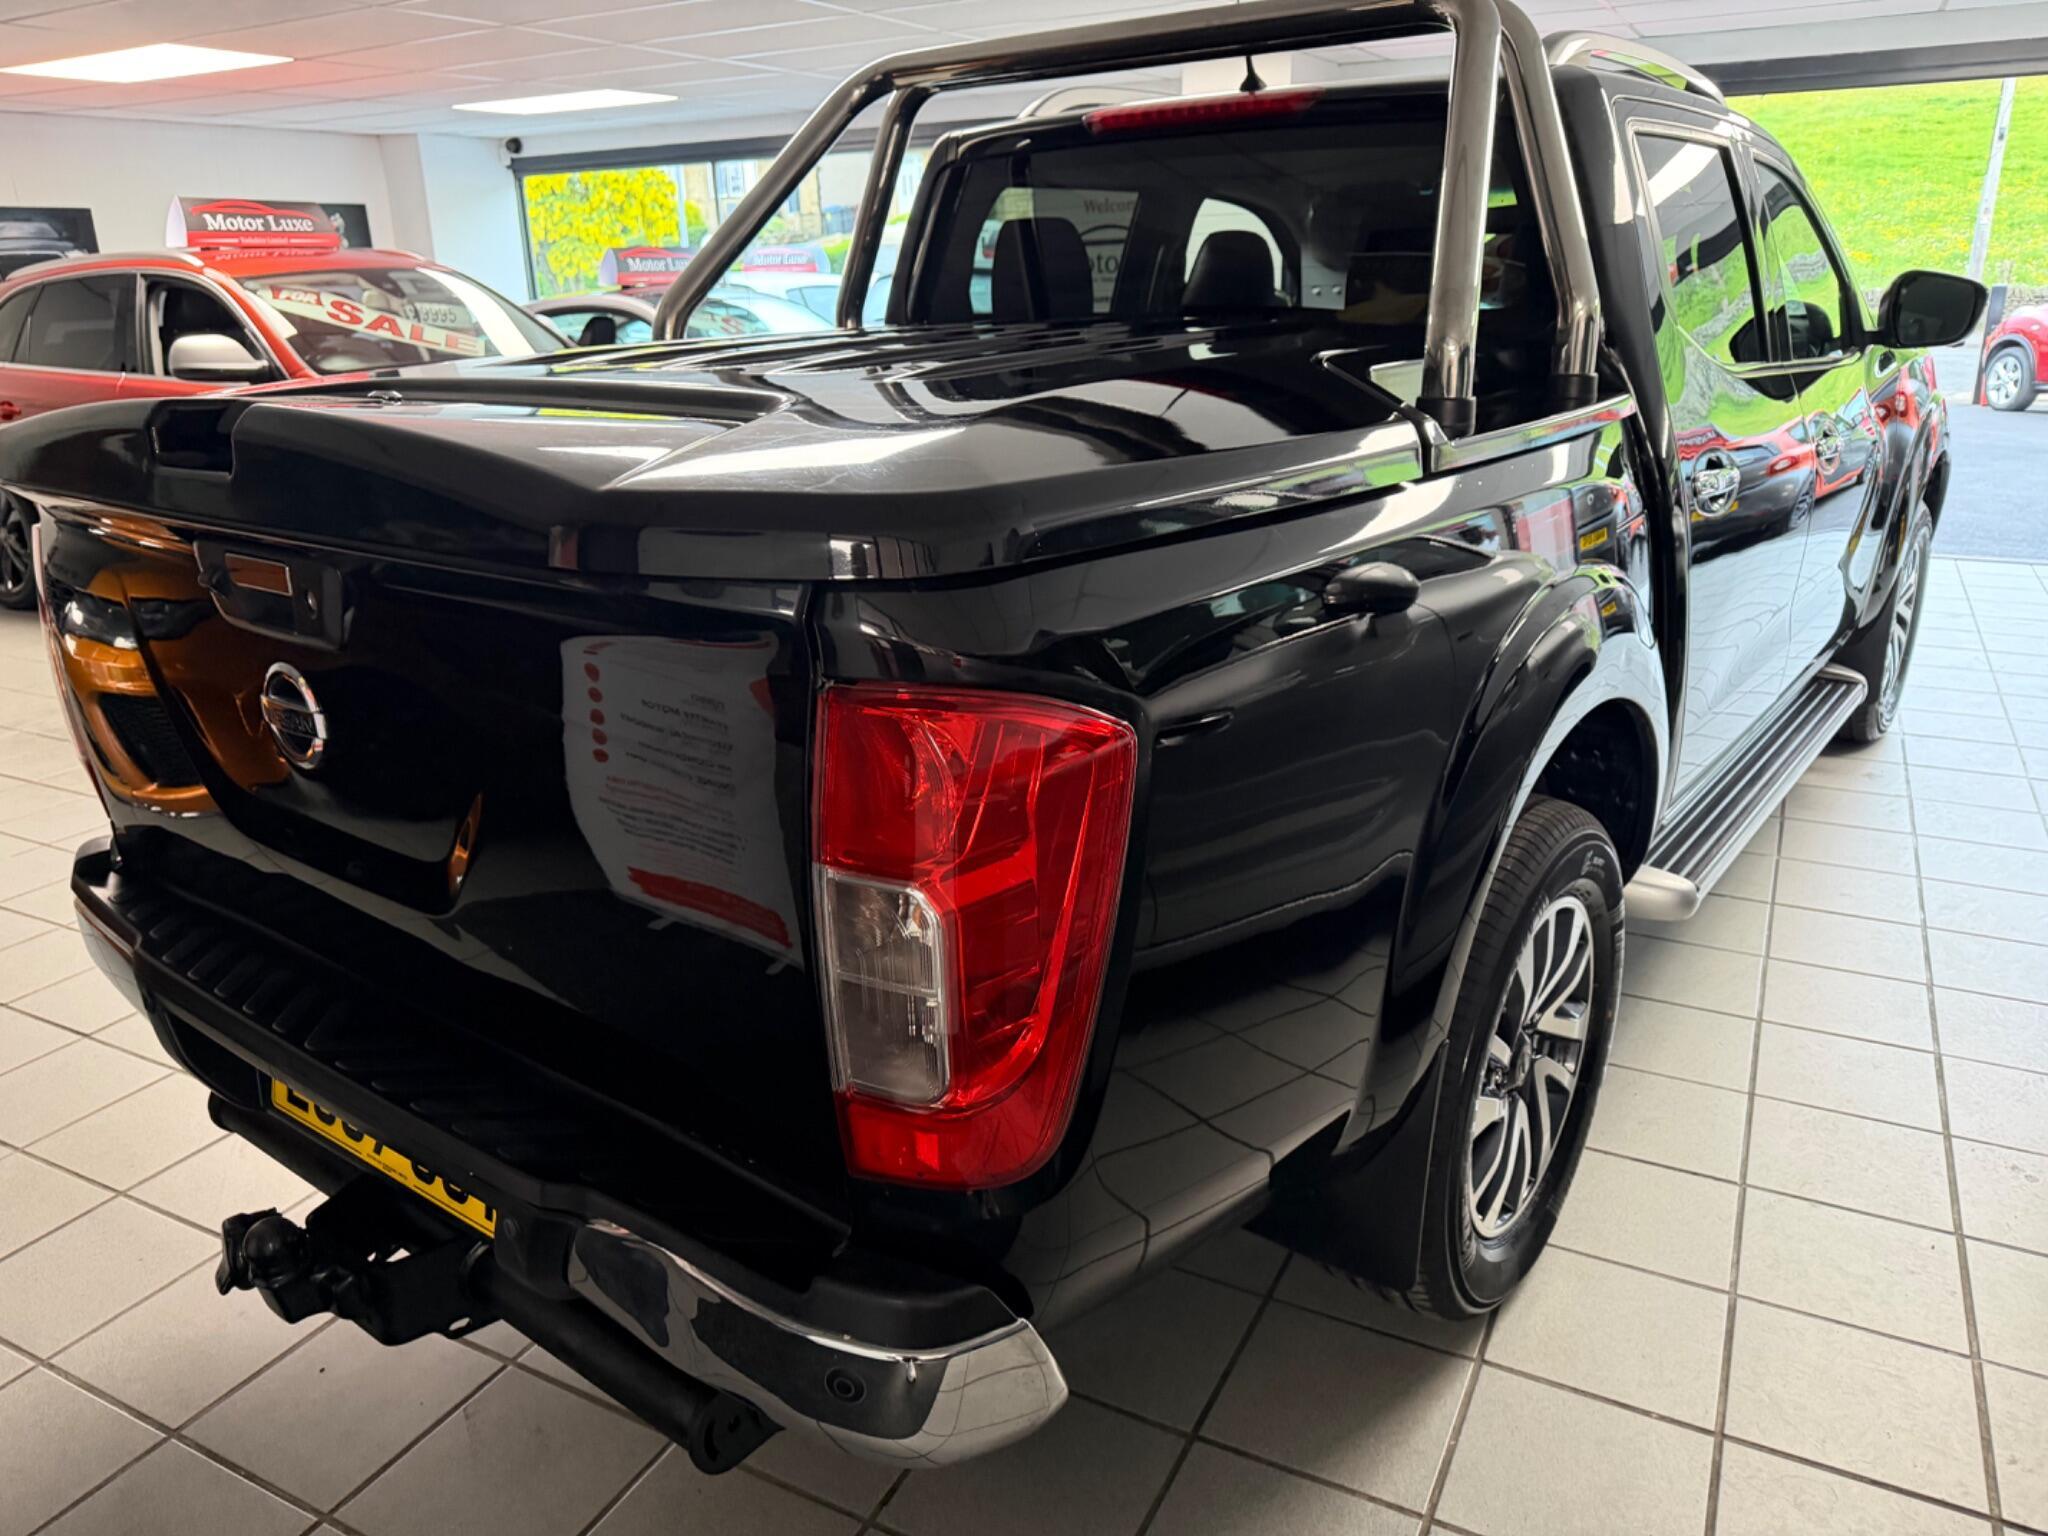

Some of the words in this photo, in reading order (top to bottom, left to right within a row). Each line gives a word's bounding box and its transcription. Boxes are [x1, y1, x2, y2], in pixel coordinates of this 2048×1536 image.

[202, 213, 265, 231] Motor
[266, 214, 314, 232] Luxe
[626, 257, 666, 271] Motor
[278, 288, 318, 304] FOR
[326, 299, 478, 350] SALE
